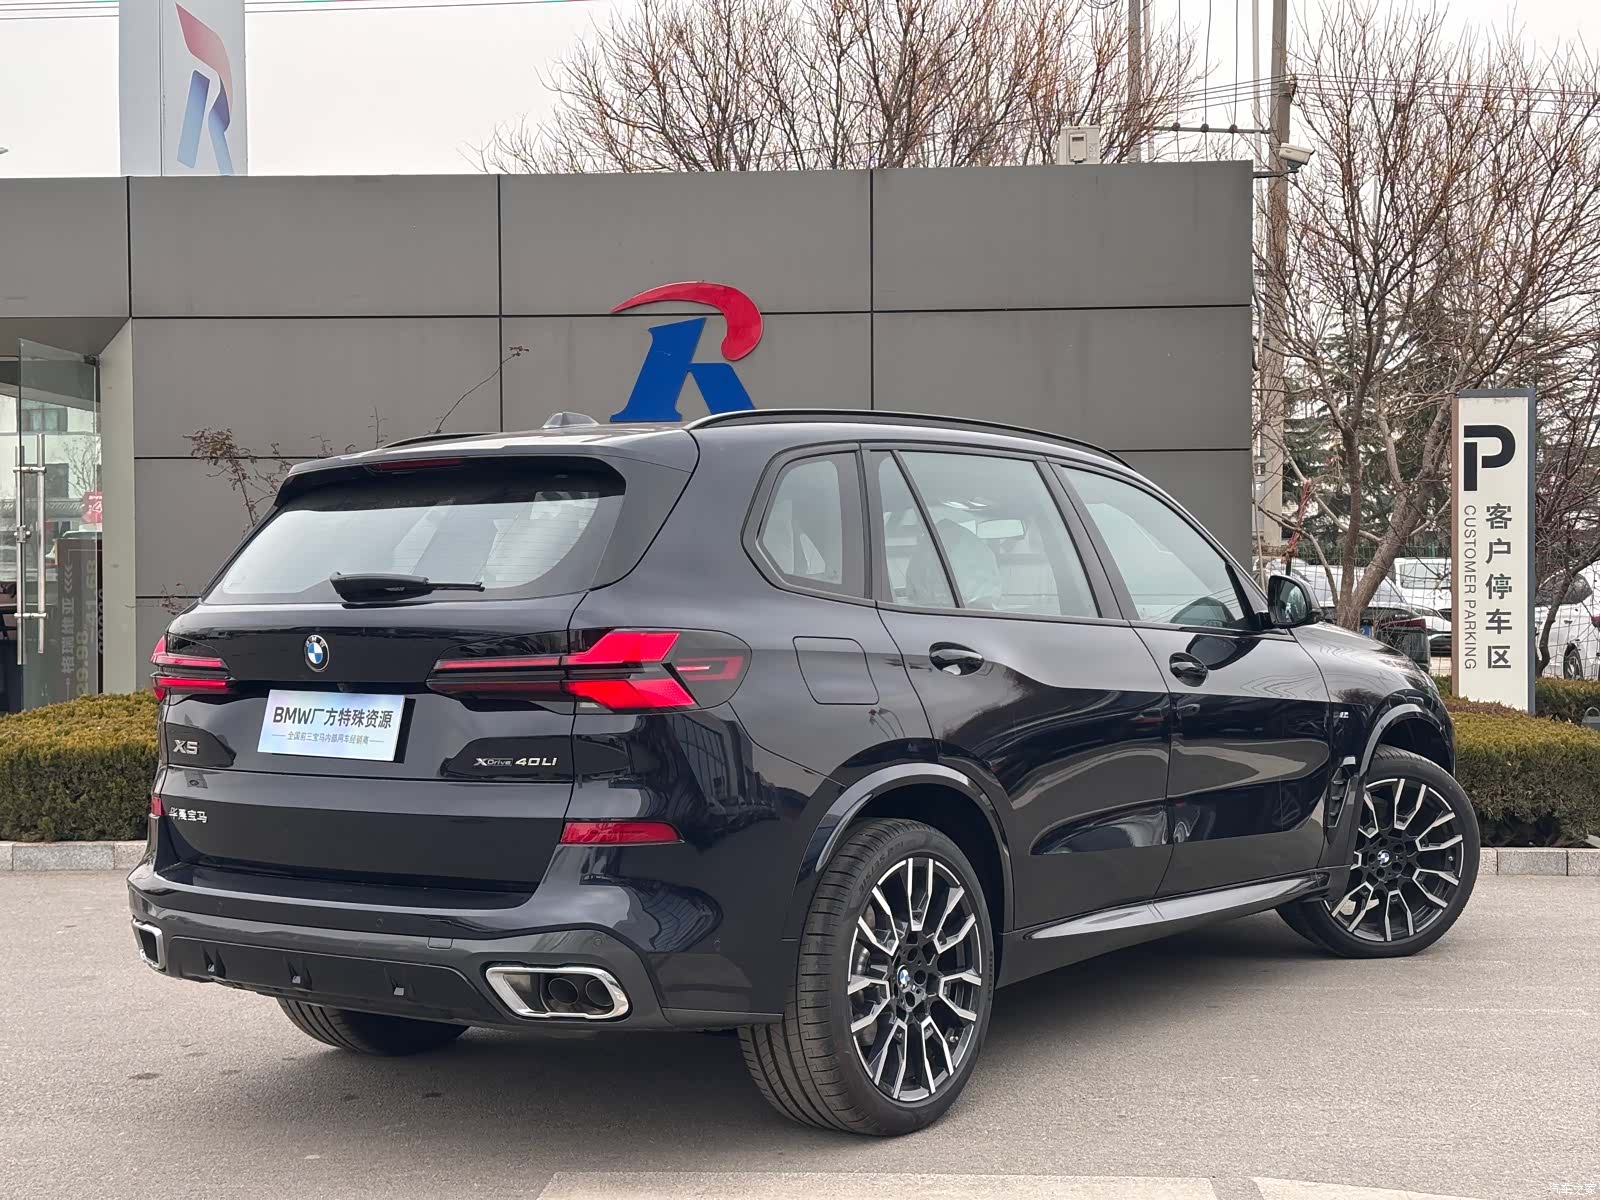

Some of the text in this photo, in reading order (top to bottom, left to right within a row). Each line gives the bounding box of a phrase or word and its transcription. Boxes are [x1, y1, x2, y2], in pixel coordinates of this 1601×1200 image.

[1463, 424, 1516, 491] P
[1463, 504, 1477, 670] CUSTOMER PARKING
[1485, 502, 1513, 669] 客户停车区
[273, 706, 394, 729] BMW厂方特殊资源
[173, 739, 198, 755] X5
[168, 806, 208, 824] 华夏宝马
